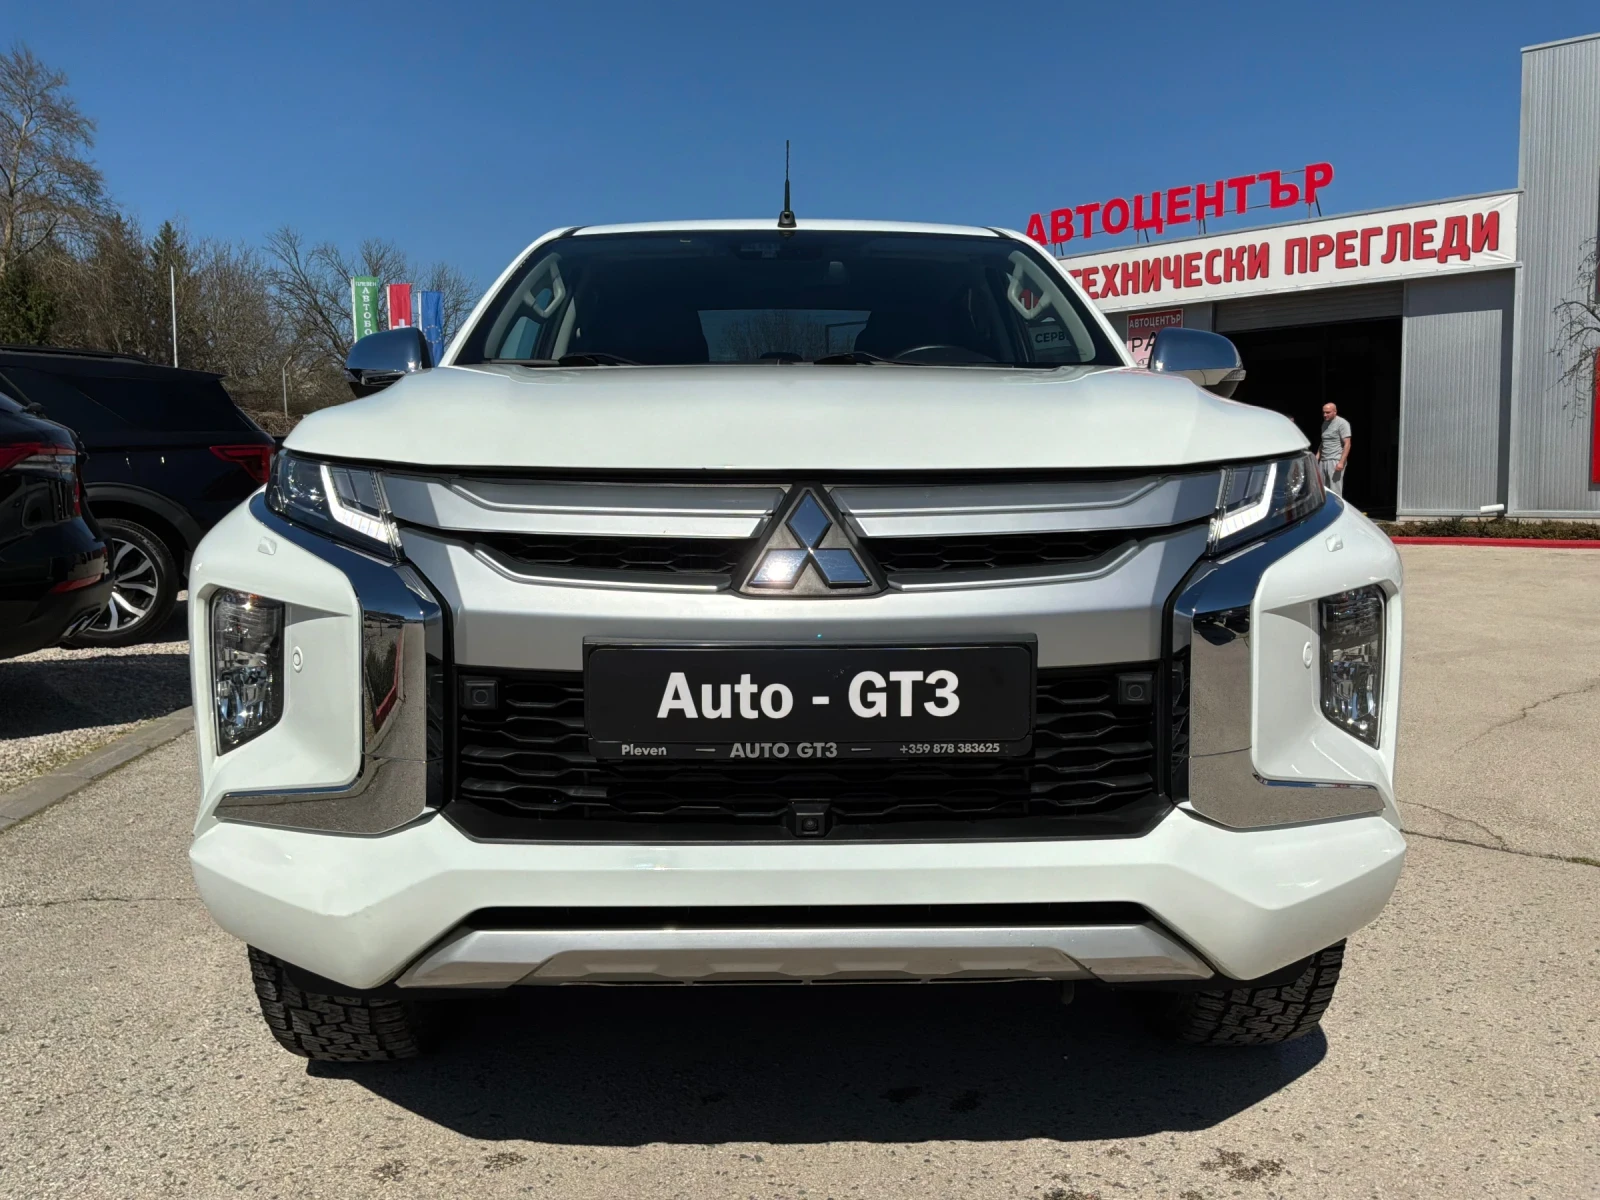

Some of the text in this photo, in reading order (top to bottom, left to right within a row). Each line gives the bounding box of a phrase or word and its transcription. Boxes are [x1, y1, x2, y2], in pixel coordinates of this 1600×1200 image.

[1025, 162, 1334, 246] АВТОЦЕНТЪР
[1284, 211, 1500, 275] ПРЕГЛЕДИ
[1129, 314, 1181, 328] АВТОЦЕНТЪР
[656, 672, 794, 720] Auto
[848, 670, 960, 718] GT3
[621, 743, 667, 756] Pleven
[730, 742, 838, 758] AUTO GT3
[900, 743, 1000, 754] +359 878 383625
